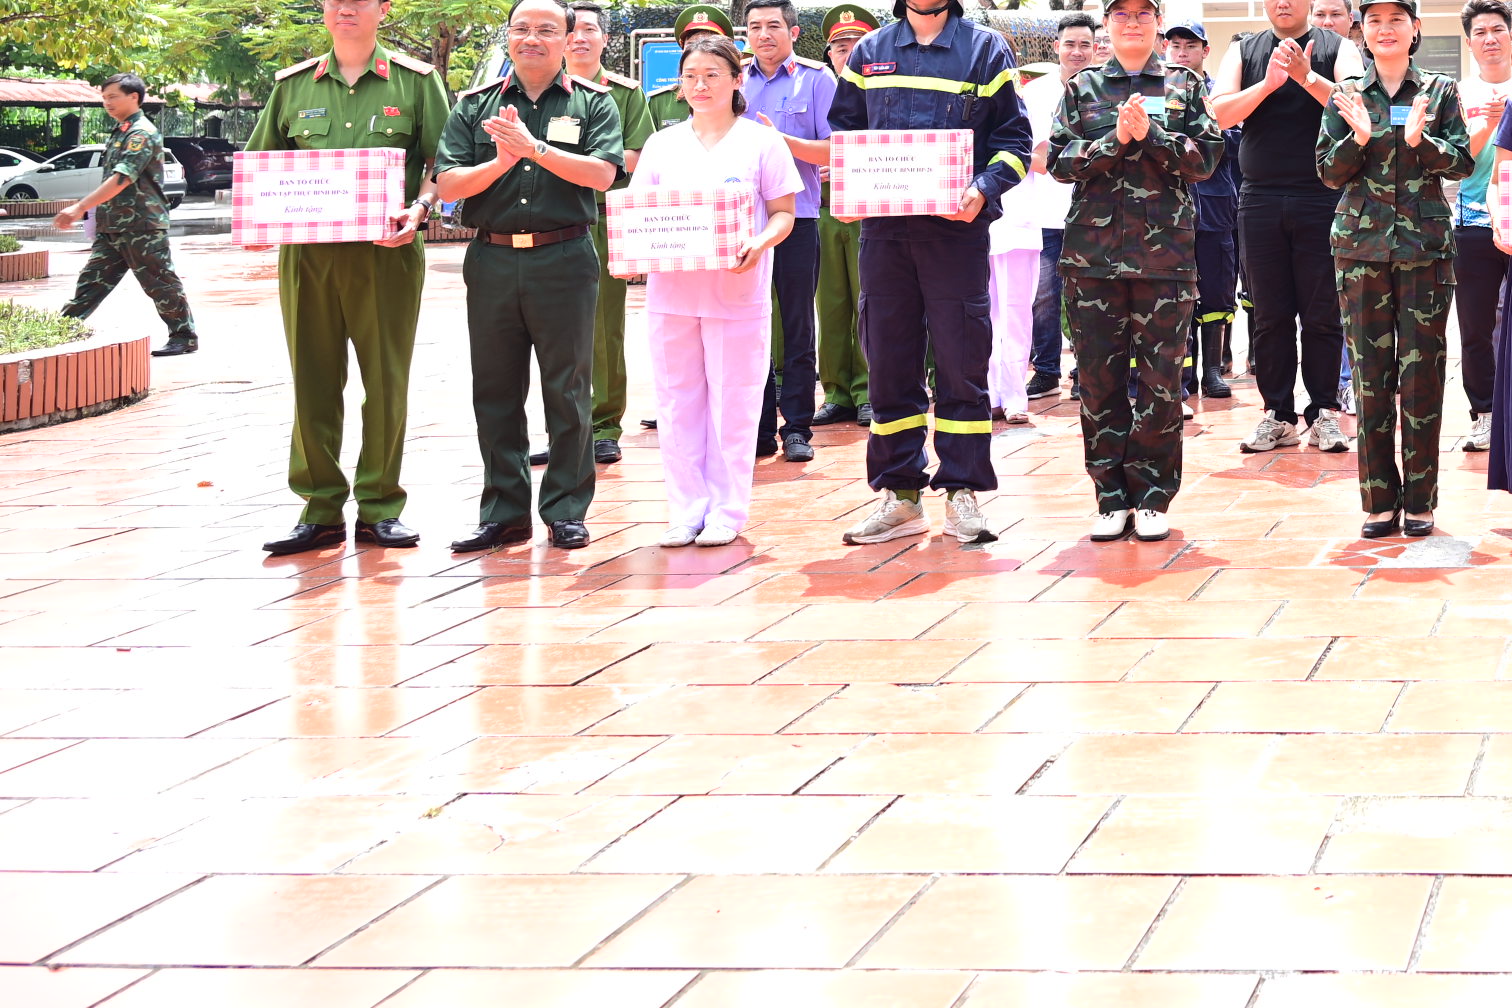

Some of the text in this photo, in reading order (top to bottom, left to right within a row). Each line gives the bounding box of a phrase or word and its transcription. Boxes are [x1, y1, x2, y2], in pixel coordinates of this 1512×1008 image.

[284, 204, 303, 213] Kính
[644, 215, 659, 223] BAN
[650, 241, 668, 250] Kính
